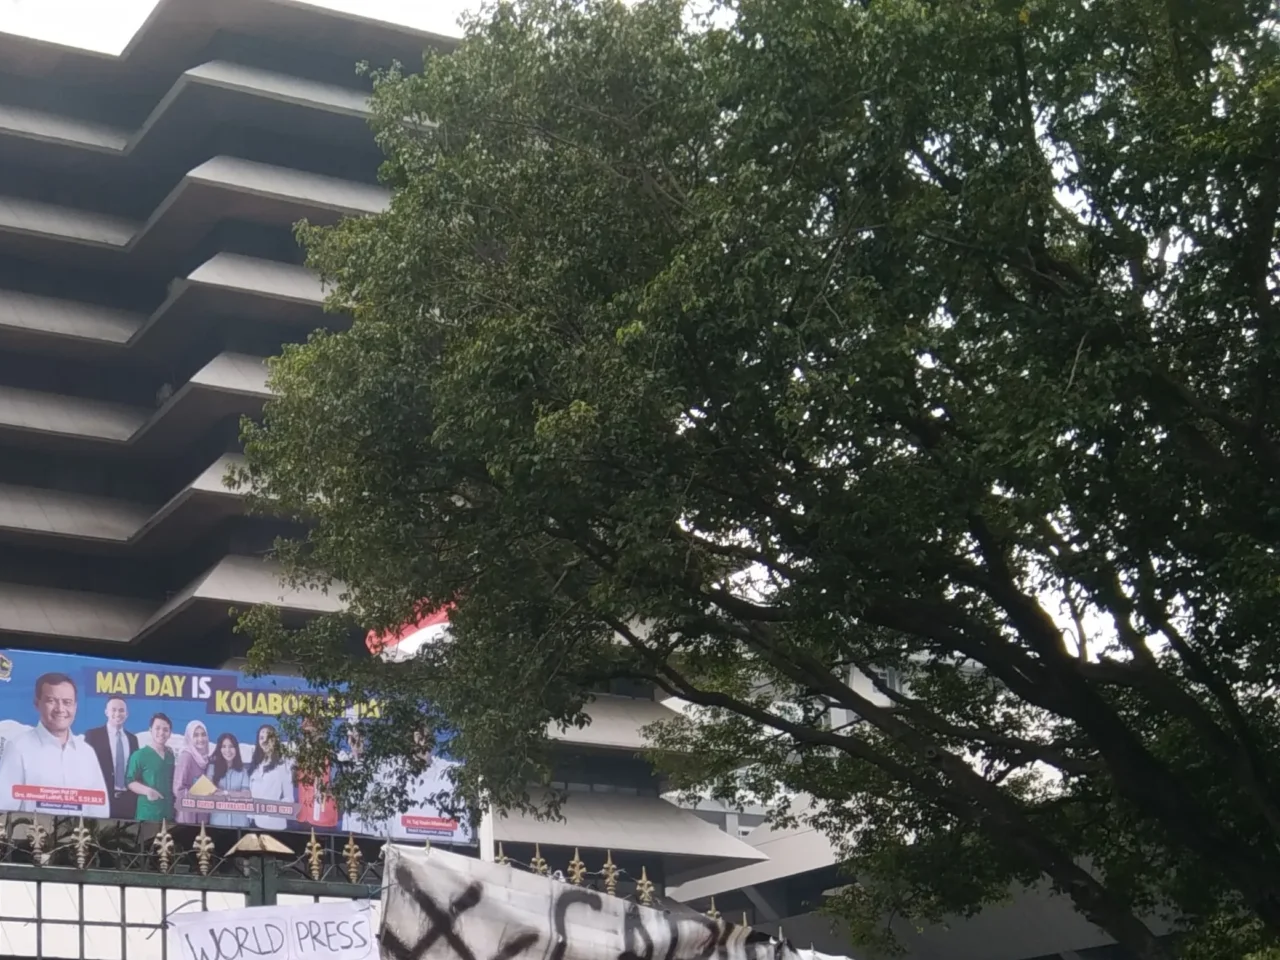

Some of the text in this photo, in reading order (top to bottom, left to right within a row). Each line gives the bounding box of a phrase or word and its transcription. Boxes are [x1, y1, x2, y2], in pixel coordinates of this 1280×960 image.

[96, 671, 212, 699] MAY DAY IS
[295, 920, 368, 953] PRESS
